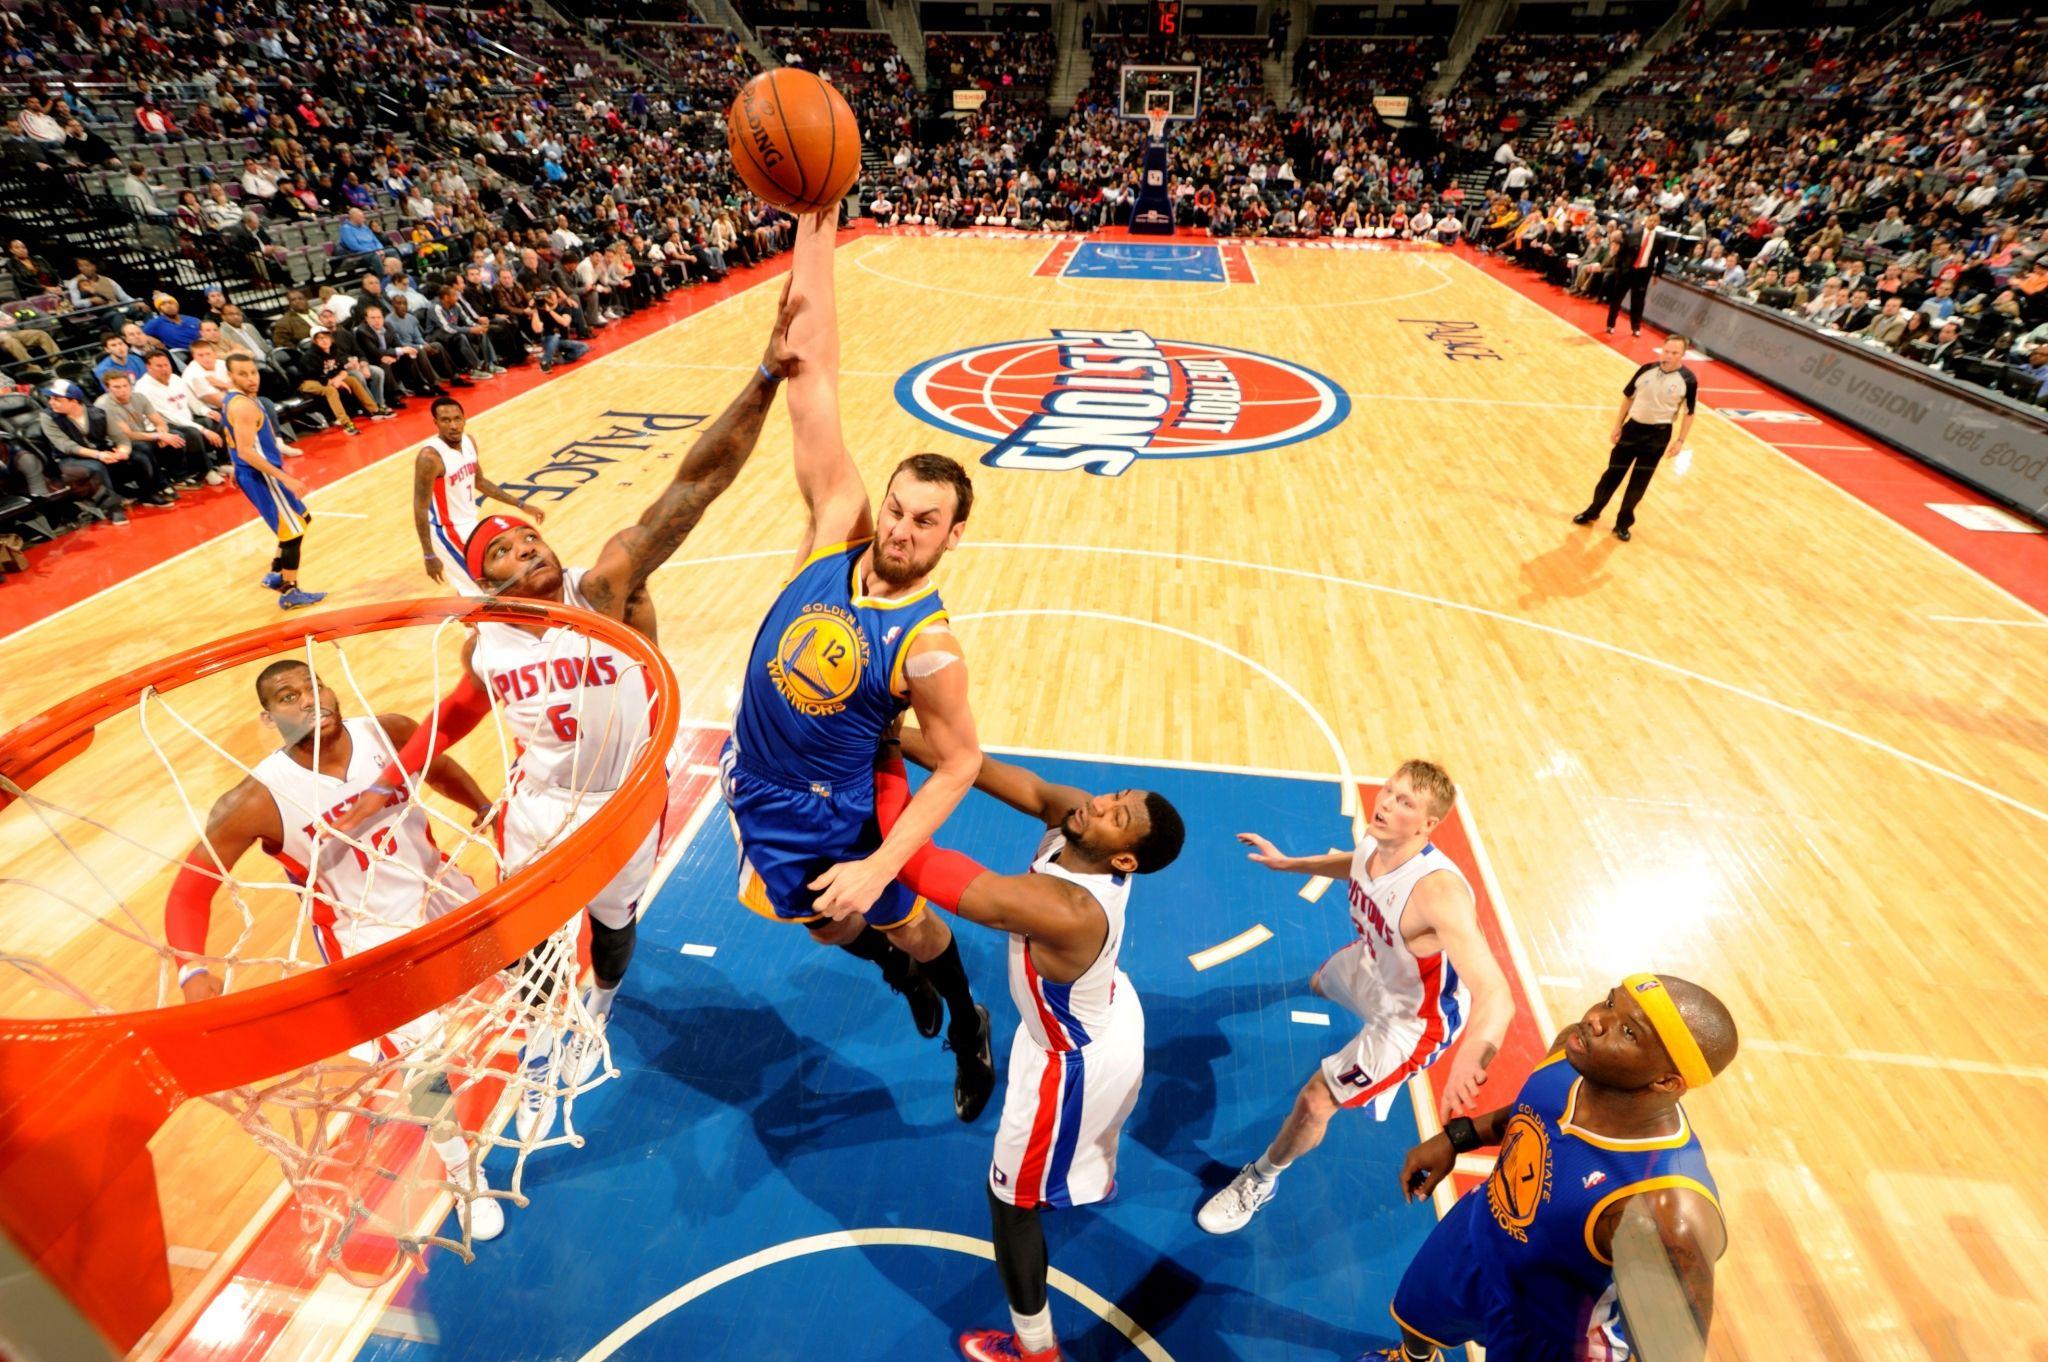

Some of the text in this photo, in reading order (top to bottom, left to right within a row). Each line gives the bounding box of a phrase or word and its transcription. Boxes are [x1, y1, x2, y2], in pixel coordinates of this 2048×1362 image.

[1160, 13, 1175, 33] 15
[979, 328, 1172, 477] PISTONS
[1170, 359, 1242, 434] DETROIT
[1845, 374, 1929, 425] VISION
[1980, 440, 2047, 482] good
[802, 602, 871, 668] GOLDEN STATE
[822, 639, 846, 668] 12
[492, 655, 618, 705] PISTONS
[766, 657, 847, 716] WARRIORS
[546, 703, 584, 742] 6
[1337, 1063, 1373, 1088] P
[1518, 1103, 1553, 1204] GOLDEN STATE
